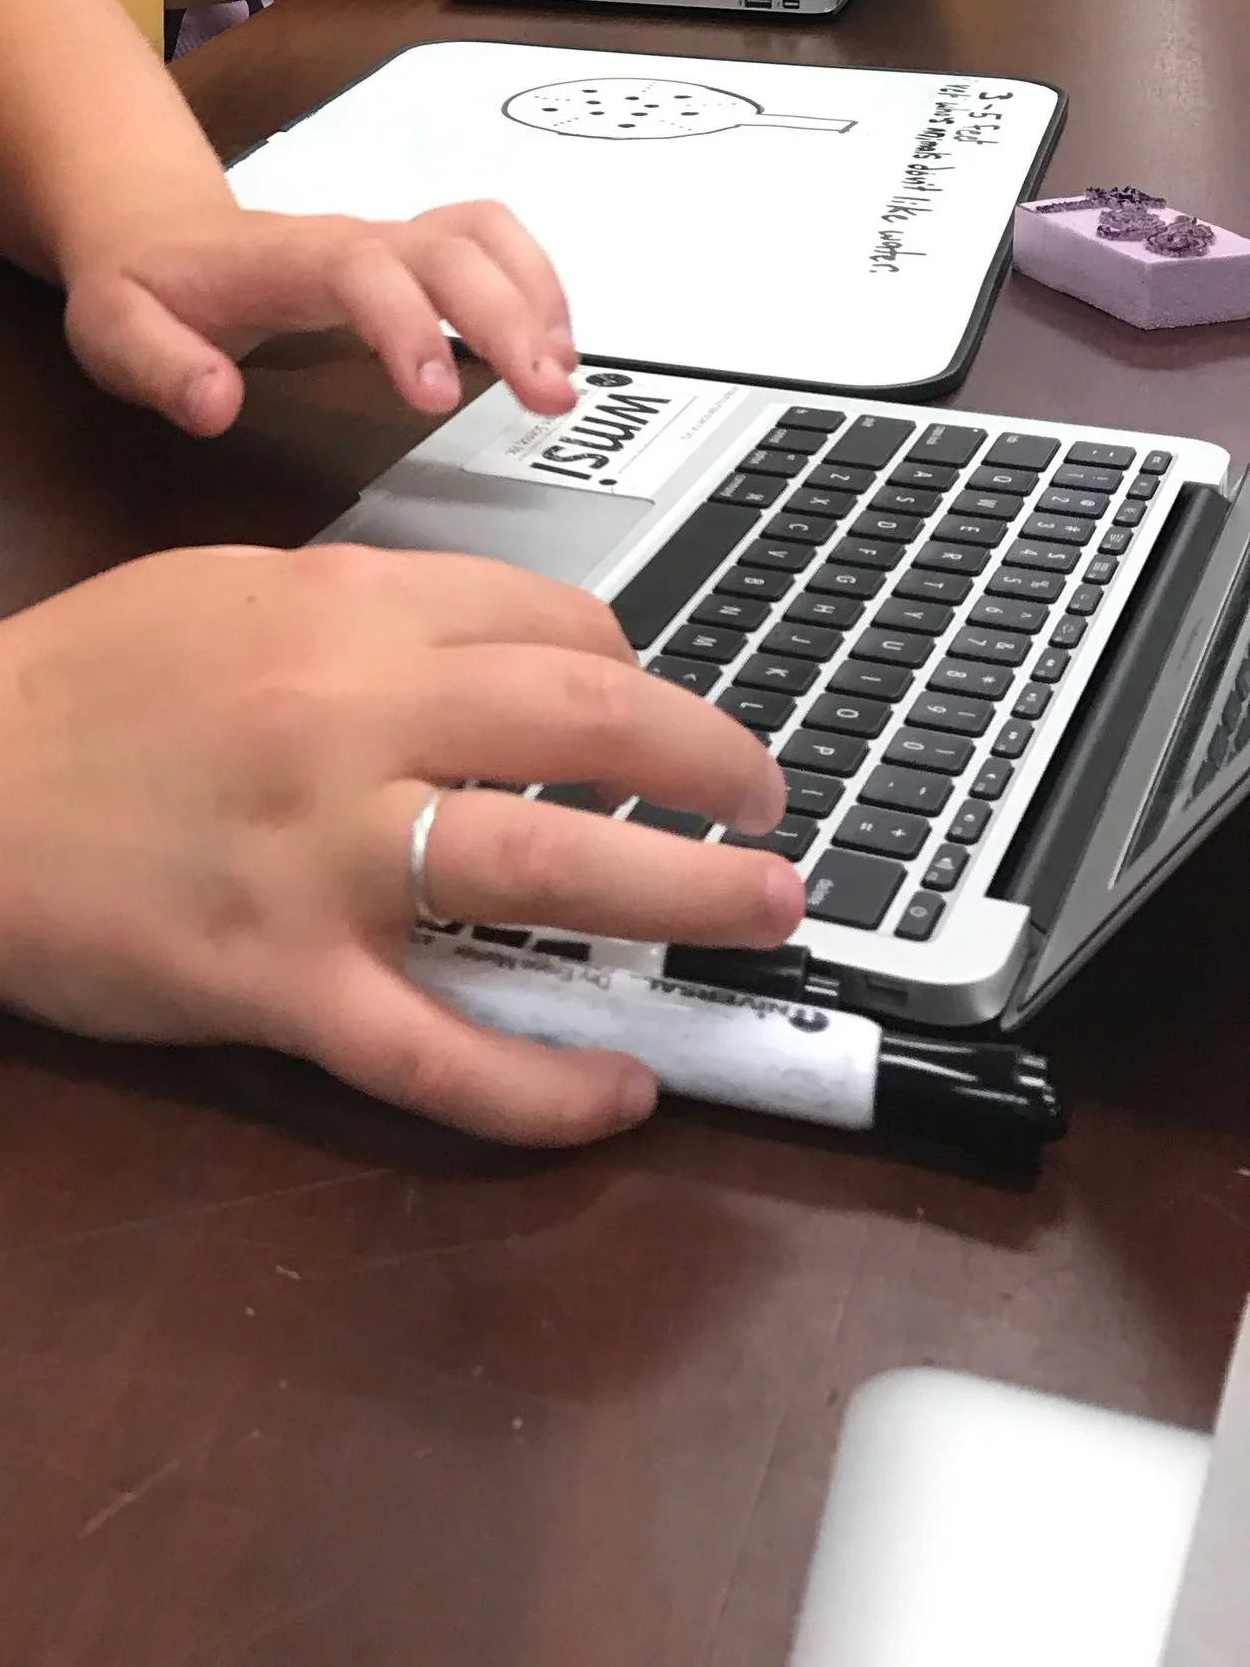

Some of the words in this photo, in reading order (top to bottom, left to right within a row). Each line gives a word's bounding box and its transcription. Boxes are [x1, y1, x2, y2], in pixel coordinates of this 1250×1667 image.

[880, 195, 934, 223] like
[529, 392, 671, 486] wmsi
[830, 472, 850, 481] Z
[913, 470, 933, 478] A
[809, 496, 830, 506] X
[896, 495, 915, 503] S
[1051, 495, 1070, 503] 2
[788, 523, 809, 532] C
[959, 525, 980, 533] E
[1036, 521, 1055, 529] 3
[767, 549, 789, 558] V
[858, 547, 877, 556] F
[941, 551, 963, 560] R
[1020, 548, 1039, 556] 4
[835, 574, 857, 584] G
[1003, 576, 1022, 584] 5
[923, 581, 945, 589] T
[718, 605, 743, 616] N
[813, 603, 836, 614] H
[985, 606, 1004, 614] 6
[903, 610, 925, 620] Y
[791, 634, 812, 644] J
[967, 637, 987, 647] 7
[882, 640, 905, 651] U
[764, 666, 789, 678] K
[946, 669, 968, 679] 8
[926, 704, 947, 714] 9
[812, 744, 835, 756] P
